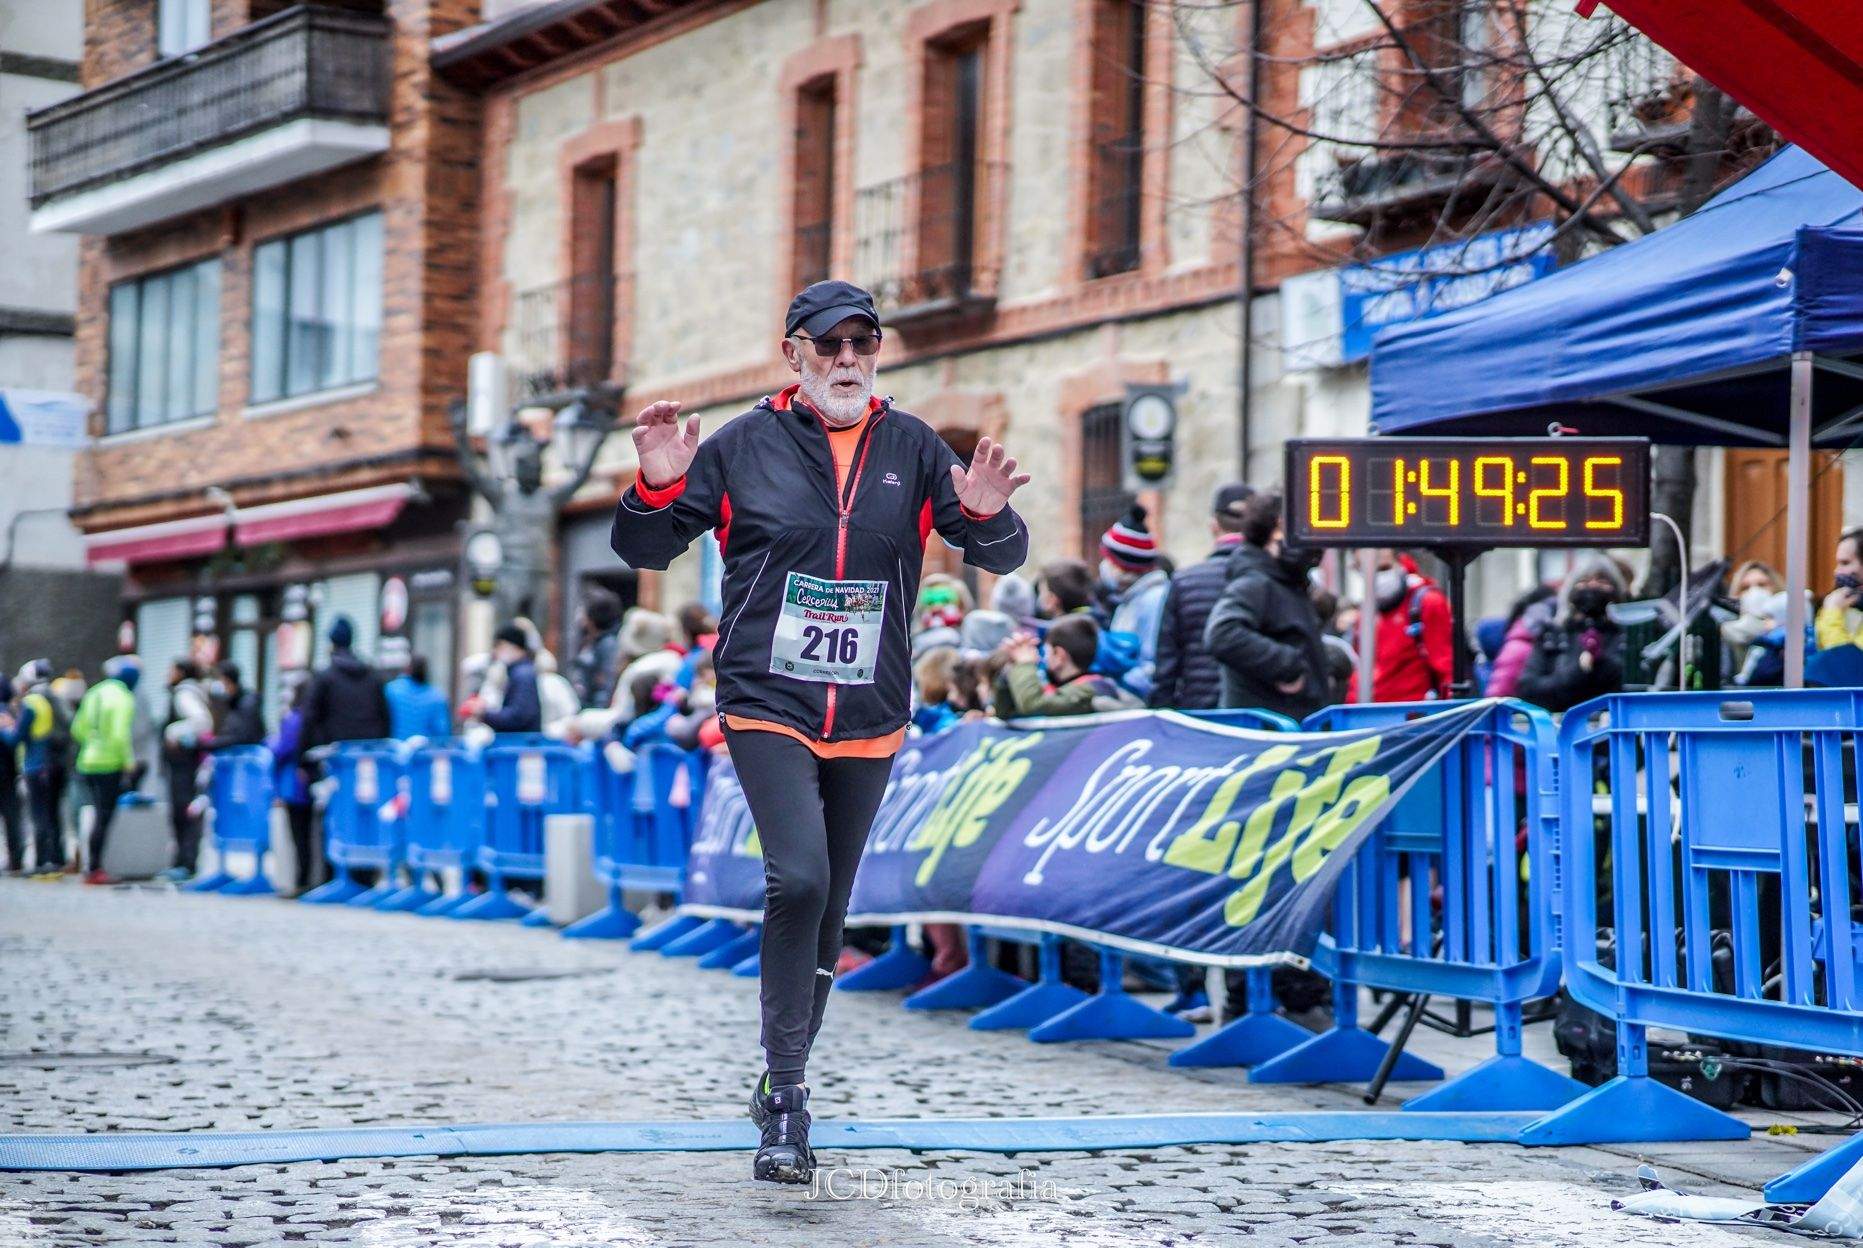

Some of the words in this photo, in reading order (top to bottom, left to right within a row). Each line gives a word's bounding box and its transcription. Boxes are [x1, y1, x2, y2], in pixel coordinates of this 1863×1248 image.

[793, 579, 824, 592] CARRERA
[825, 586, 834, 594] DE
[835, 586, 865, 594] NAVIDAD
[800, 625, 859, 665] 216
